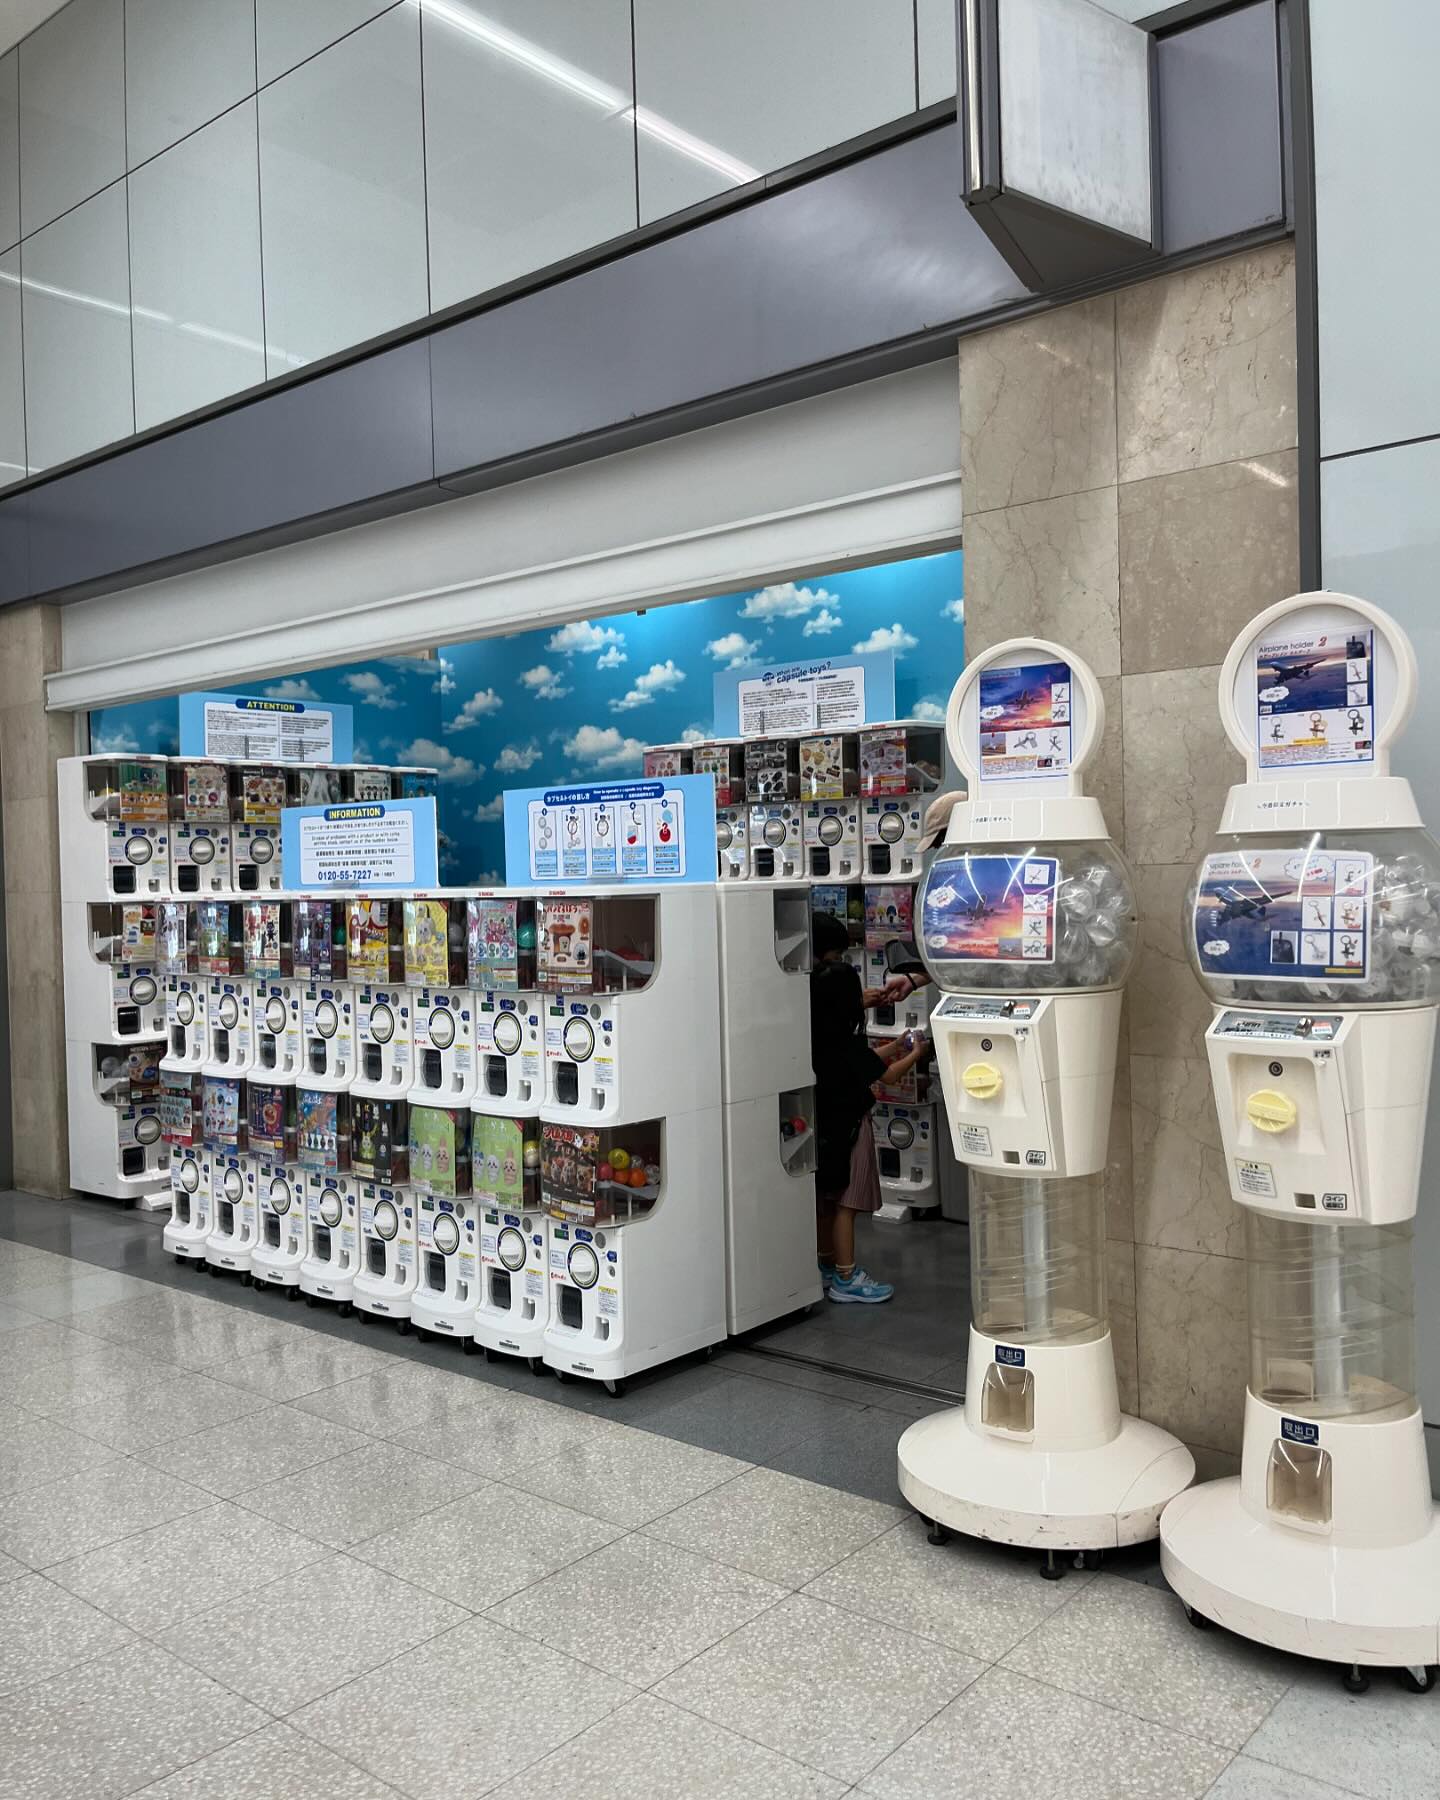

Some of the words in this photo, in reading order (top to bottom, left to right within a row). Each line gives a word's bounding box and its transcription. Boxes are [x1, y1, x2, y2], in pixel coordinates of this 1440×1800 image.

[1258, 643, 1288, 653] Airplane
[1290, 641, 1314, 649] holder
[1318, 636, 1328, 647] 2
[777, 670, 807, 683] capsule
[810, 661, 831, 674] toys?
[247, 701, 295, 711] ATTENTION
[329, 807, 381, 820] INFORMATION
[1252, 858, 1261, 869] 2
[317, 870, 372, 881] 0120-55-7227
[997, 1348, 1022, 1360] 取出口
[1284, 1421, 1315, 1437] 取出口
